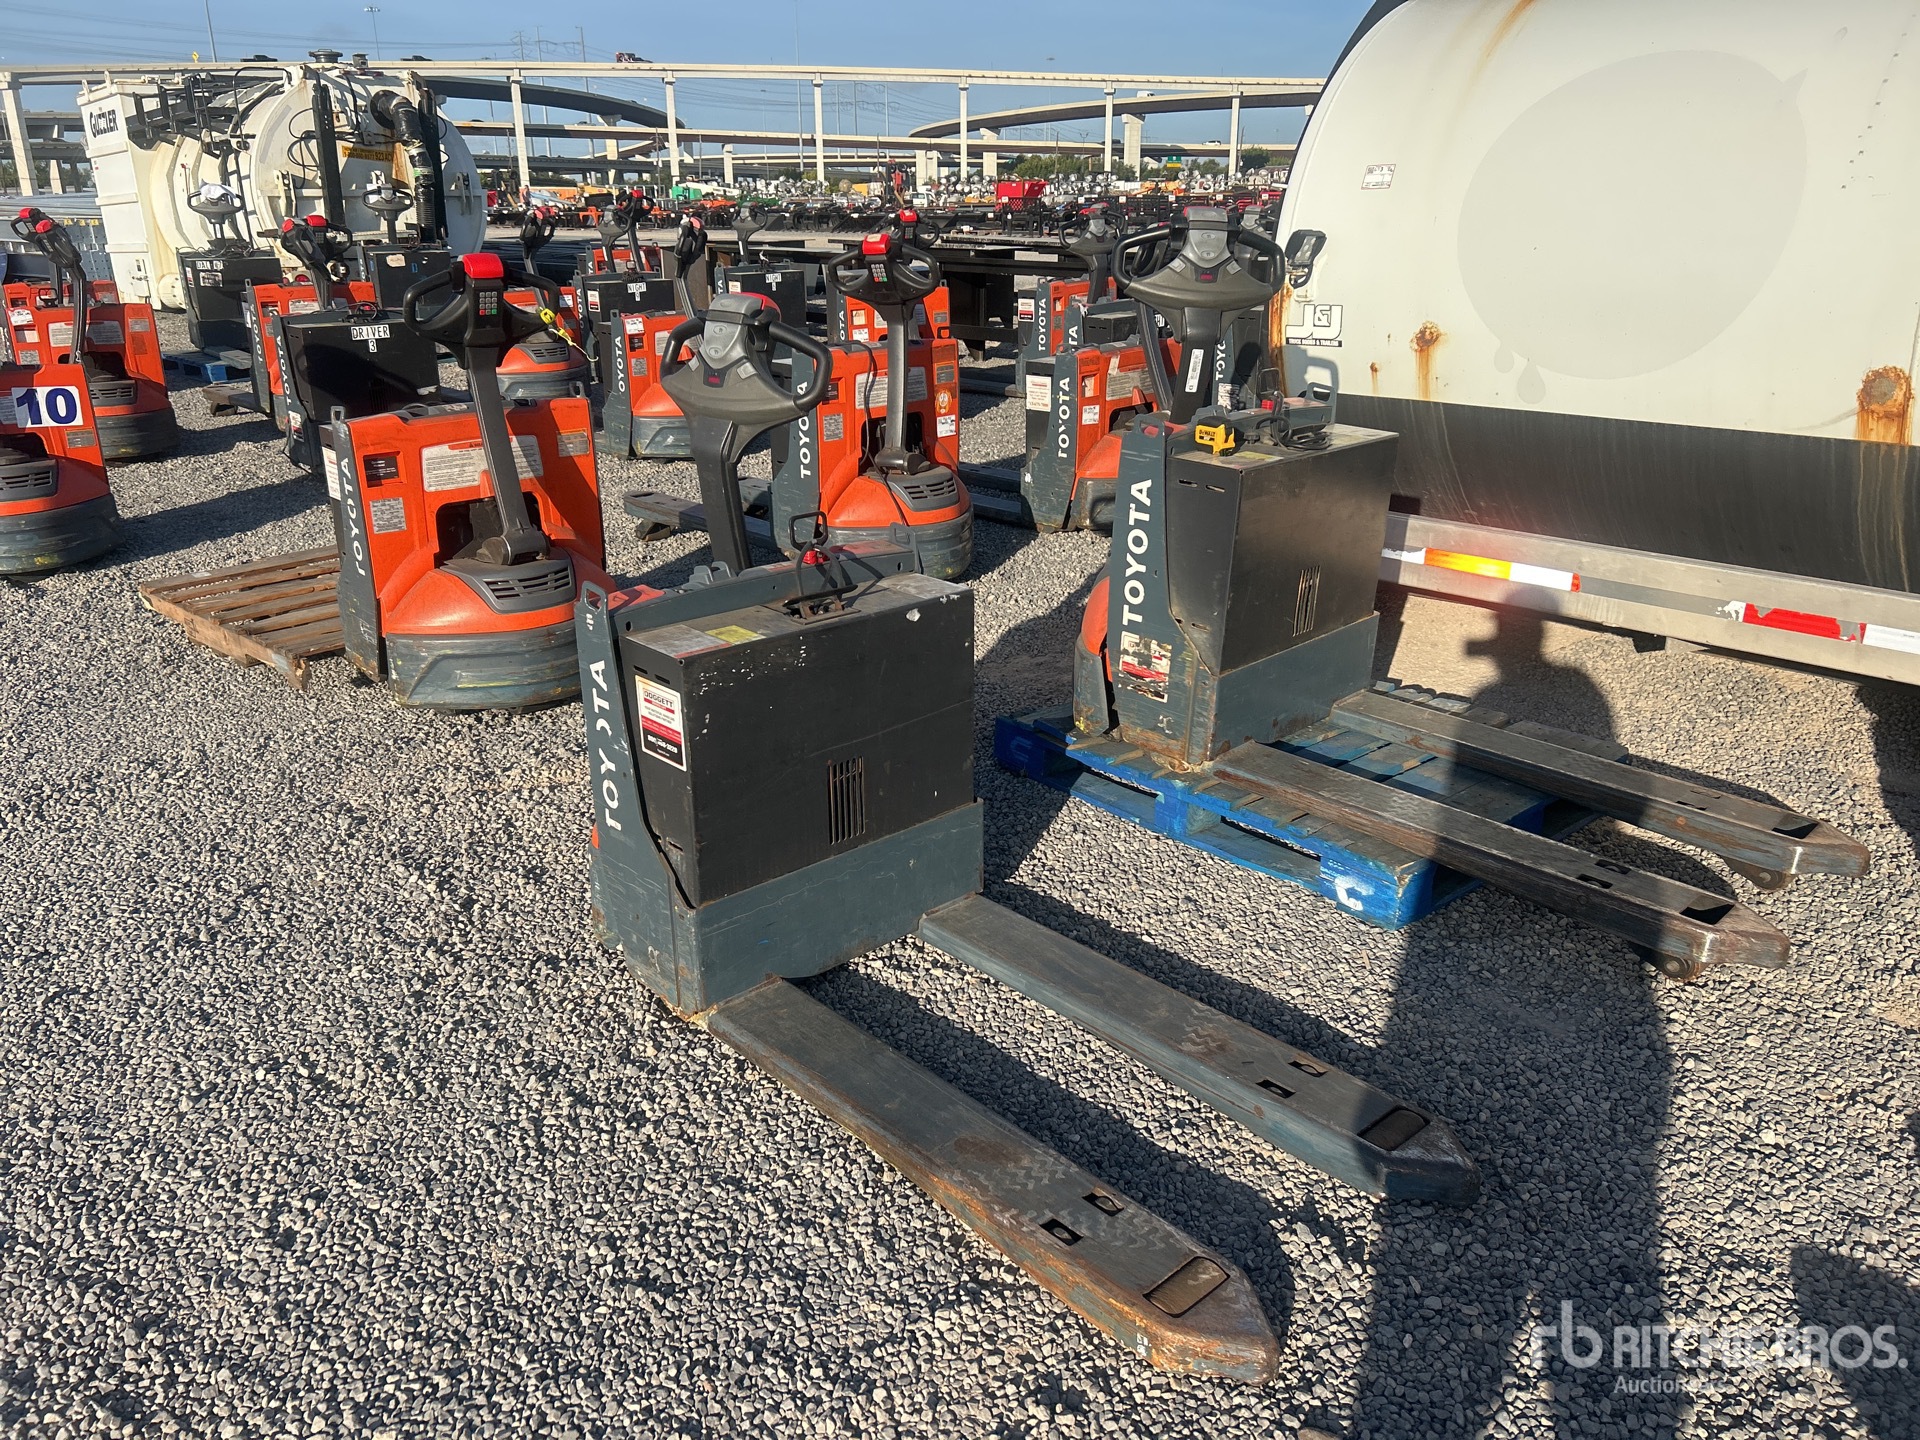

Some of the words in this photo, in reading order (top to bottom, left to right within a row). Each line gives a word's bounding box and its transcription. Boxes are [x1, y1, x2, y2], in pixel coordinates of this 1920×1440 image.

[351, 326, 390, 340] DRIVER
[369, 340, 376, 352] 3
[1038, 298, 1047, 352] TOYOTA
[277, 335, 293, 406] TOYOTA
[614, 336, 626, 393] OYOTA
[15, 387, 78, 426] 10
[795, 381, 812, 479] TOYOA
[1057, 376, 1071, 459] TOYOTA
[1121, 479, 1152, 627] TOYOTA
